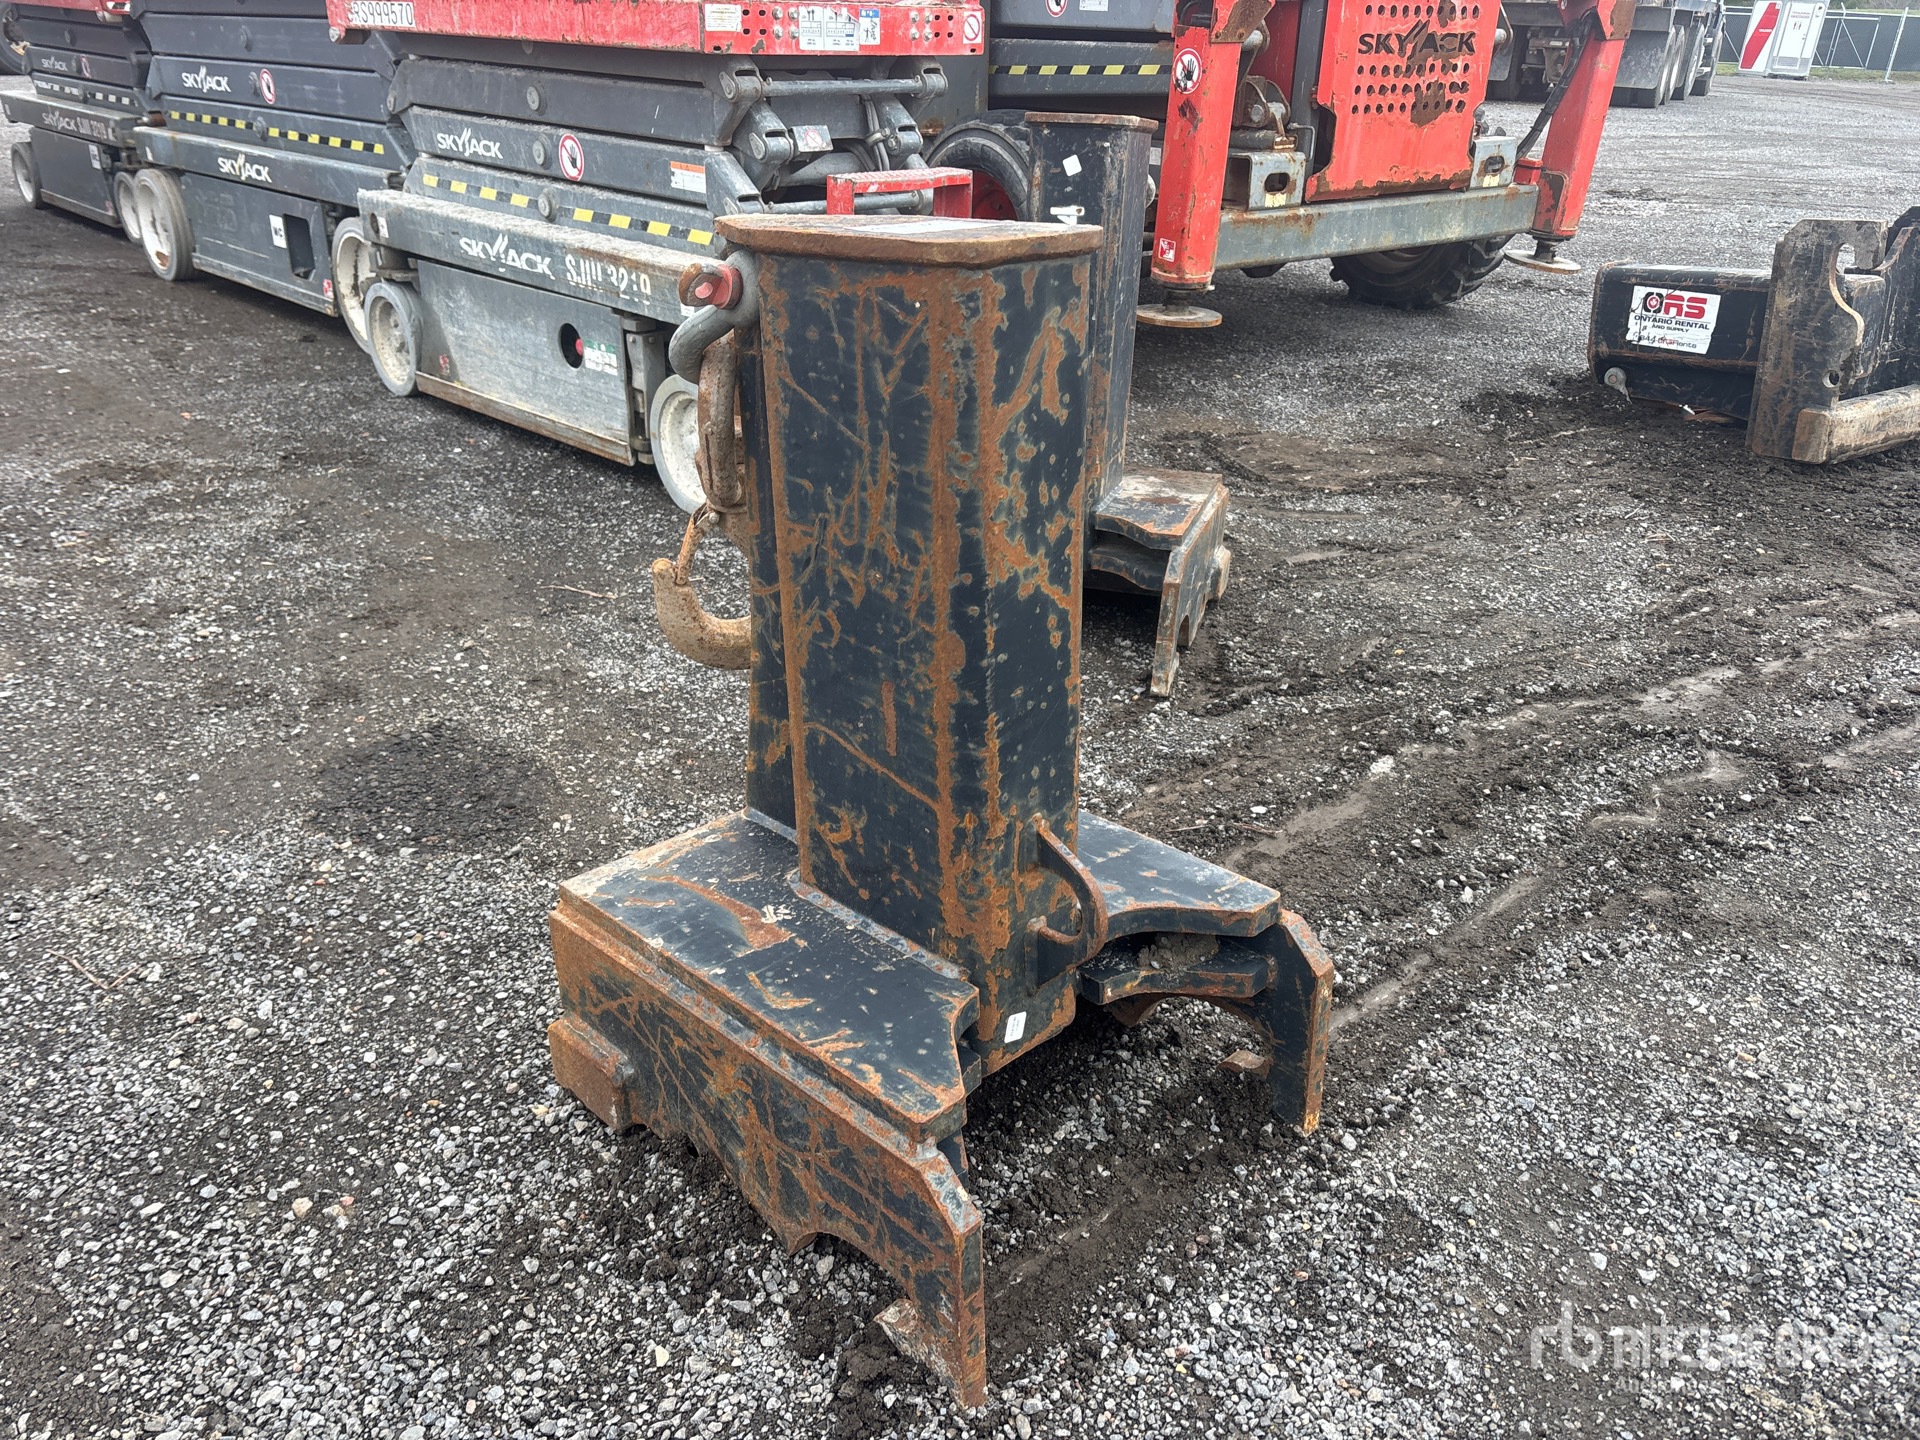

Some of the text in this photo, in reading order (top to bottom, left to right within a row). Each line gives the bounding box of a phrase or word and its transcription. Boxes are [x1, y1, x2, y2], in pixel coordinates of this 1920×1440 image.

[348, 1, 413, 26] RS999570
[1357, 18, 1476, 59] SKYJACK
[41, 56, 68, 72] SKYJACK
[181, 65, 232, 93] SKYJACK
[42, 110, 78, 132] SKYJACK
[436, 127, 503, 159] SKYJACK
[217, 153, 273, 184] SKYJACK
[459, 233, 556, 281] SKYJACK
[1643, 291, 1708, 320] ORS
[1633, 314, 1710, 331] ONTARIO RENTAL
